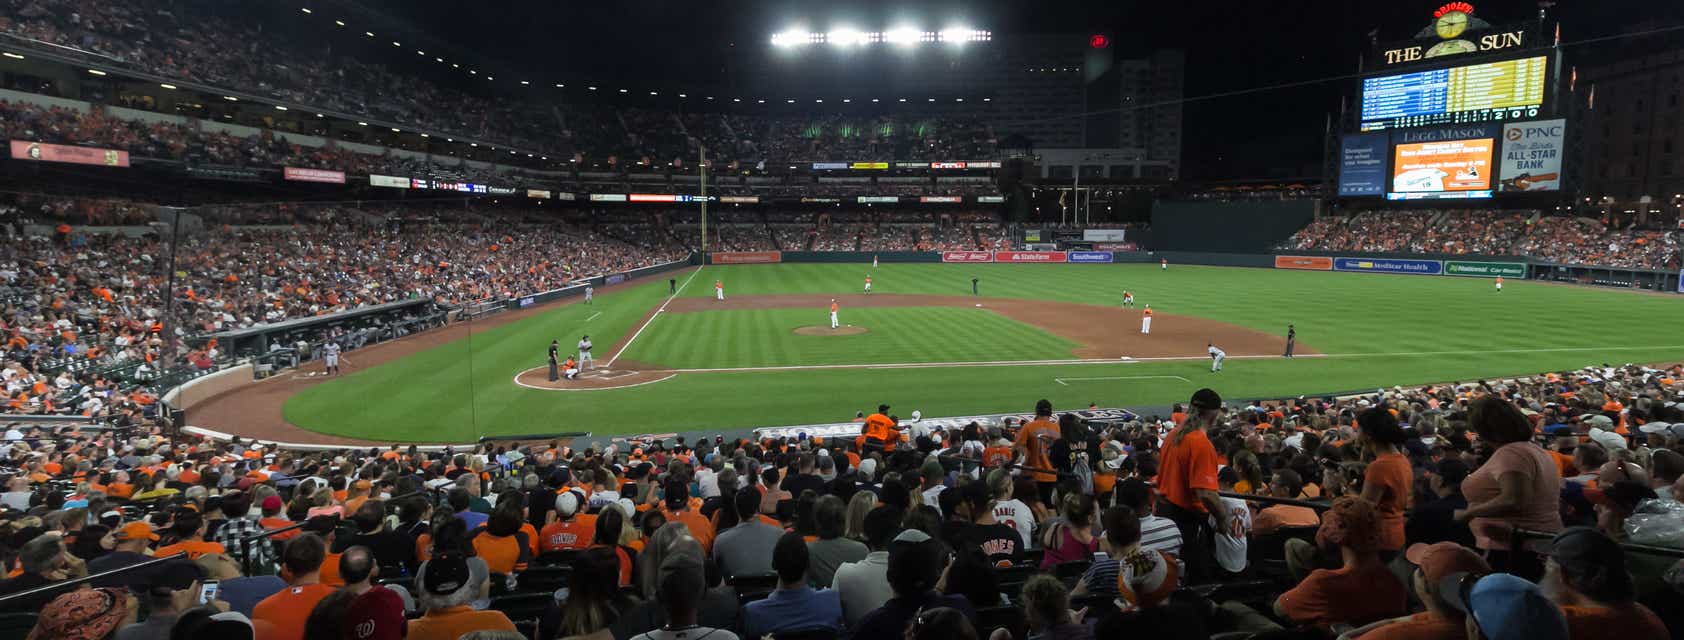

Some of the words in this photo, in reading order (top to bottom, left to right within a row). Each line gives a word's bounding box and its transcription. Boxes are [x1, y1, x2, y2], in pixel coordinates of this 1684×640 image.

[1385, 46, 1422, 64] THE
[1480, 31, 1523, 50] SUN
[1495, 112, 1503, 120] 2
[1512, 110, 1520, 118] 0
[1528, 109, 1537, 117] 0
[1404, 130, 1437, 142] LEGG
[1440, 128, 1485, 139] MASON
[1526, 126, 1562, 138] PNC
[1508, 149, 1557, 160] ALL-STAR
[1517, 160, 1543, 169] BANK
